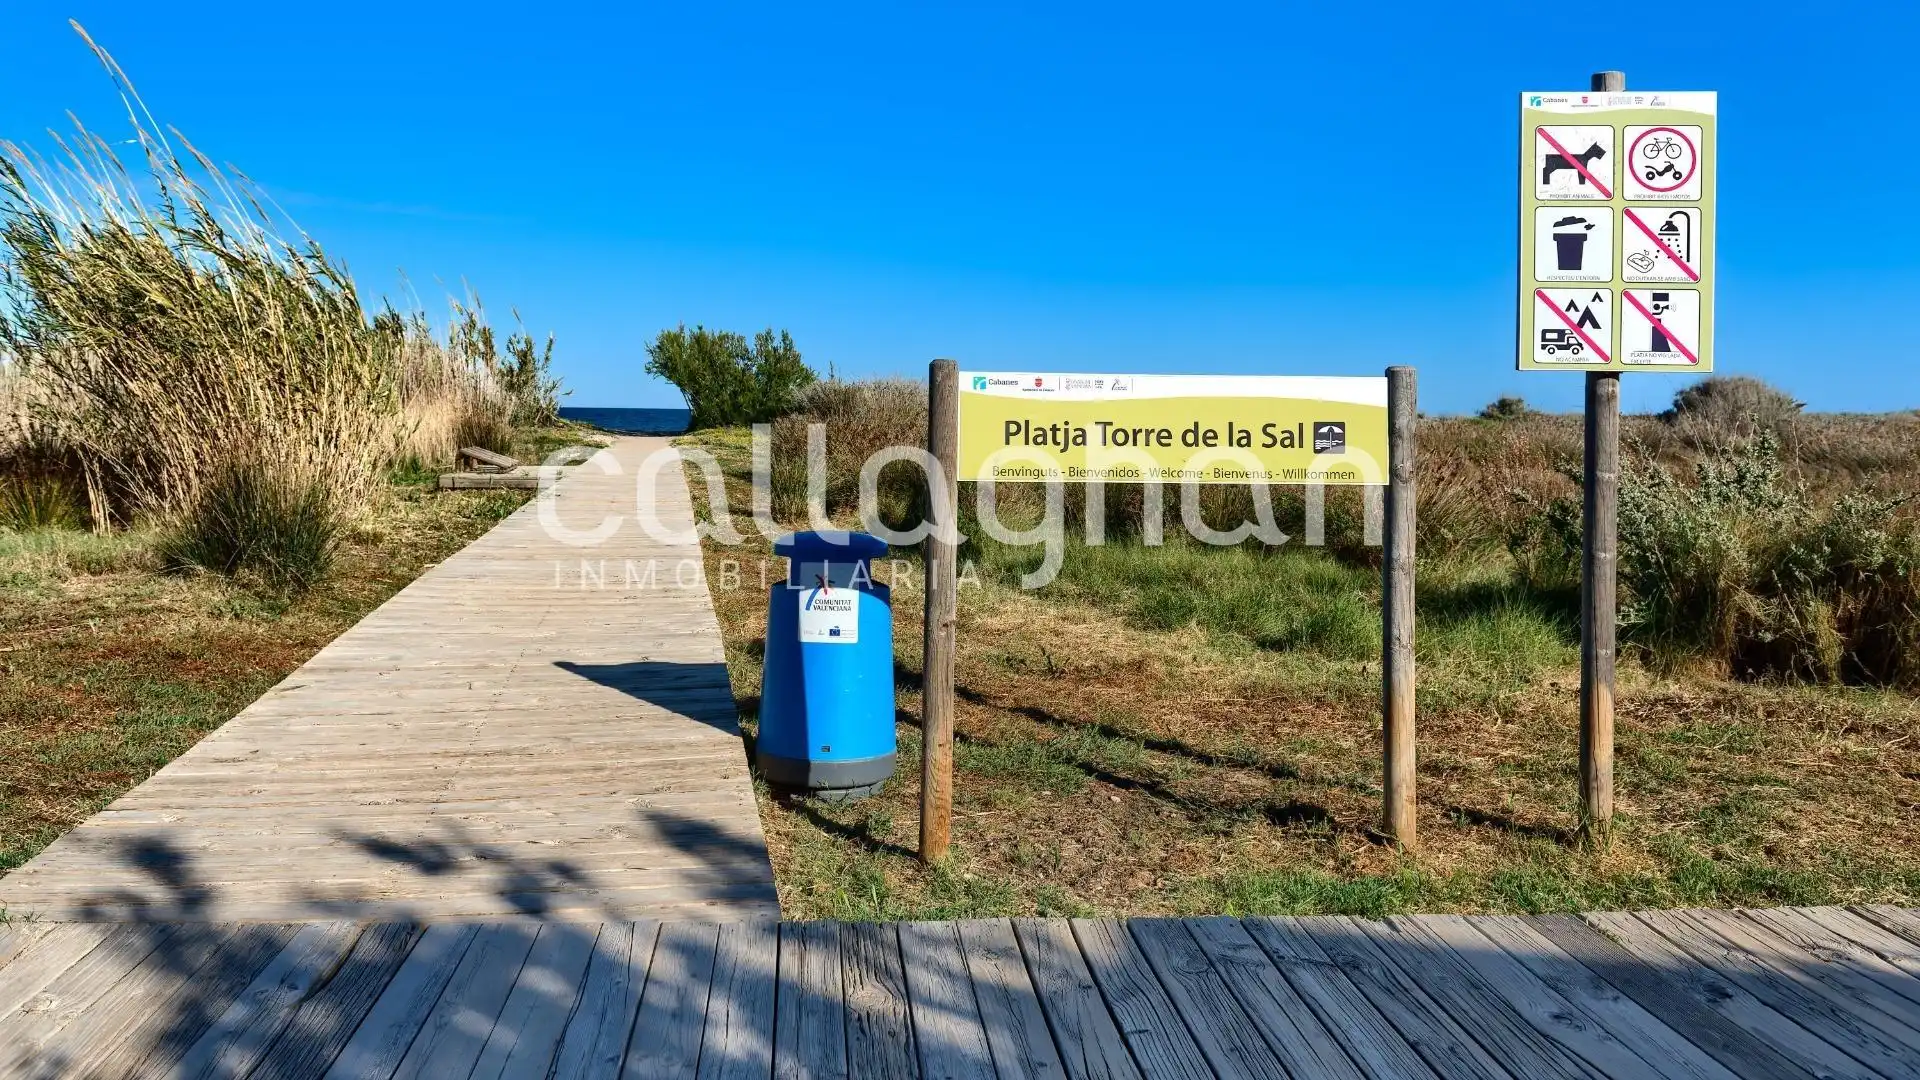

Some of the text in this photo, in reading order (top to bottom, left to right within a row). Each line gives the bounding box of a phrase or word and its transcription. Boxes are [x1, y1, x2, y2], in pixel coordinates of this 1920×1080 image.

[988, 378, 1019, 386] Cabanes
[1004, 420, 1304, 453] Platja Torre de la Sal
[992, 465, 1058, 480] Benvinguts
[1068, 466, 1140, 479] Bienvenidos
[1149, 466, 1203, 479] Welcome
[1213, 467, 1273, 479] Bienvenus
[1282, 467, 1355, 480] Willkommen
